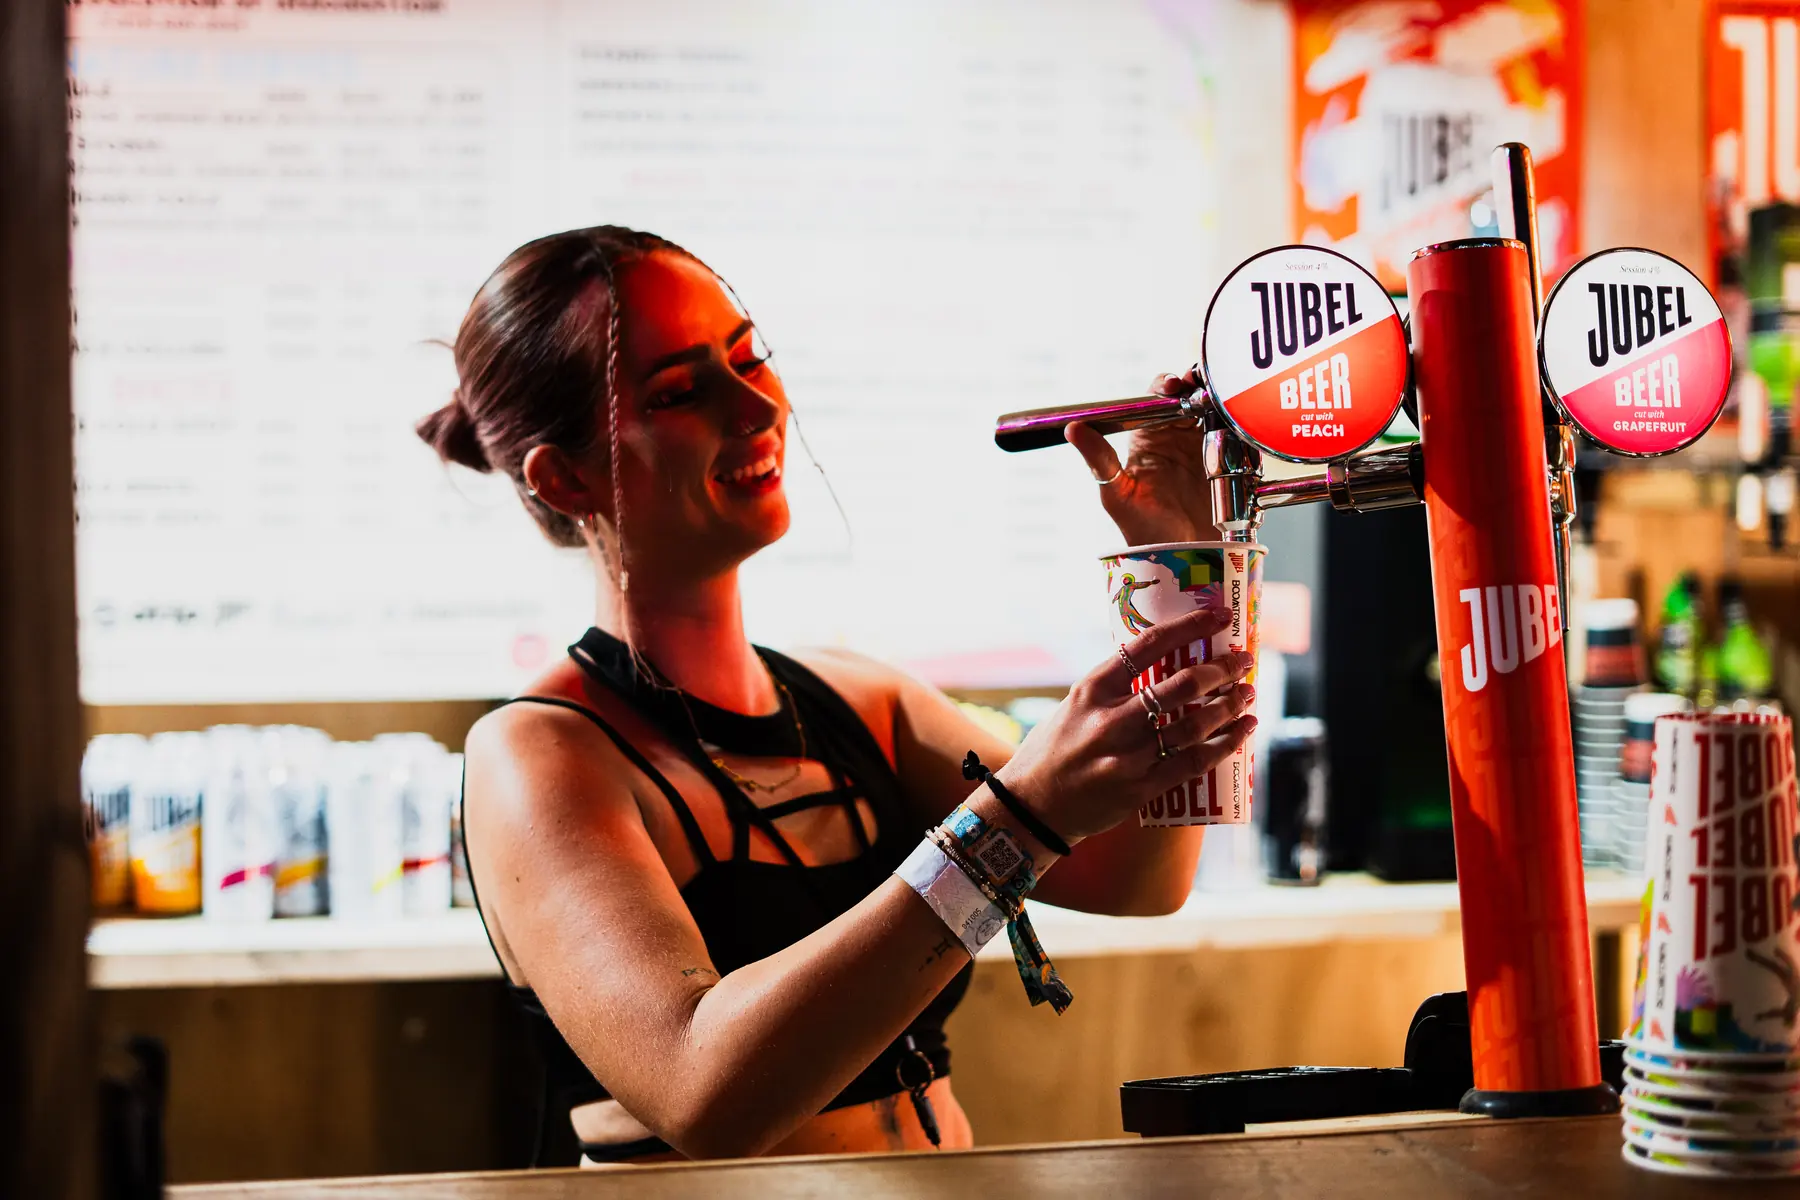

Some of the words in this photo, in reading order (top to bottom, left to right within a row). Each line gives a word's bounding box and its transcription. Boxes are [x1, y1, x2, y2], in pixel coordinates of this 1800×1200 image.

[1285, 262, 1313, 271] Session
[1619, 264, 1647, 274] Session
[1250, 282, 1363, 370] JUBEL
[1587, 282, 1692, 368] JUBEL
[1279, 352, 1352, 410] BEER
[1614, 353, 1682, 408] BEER
[1300, 413, 1314, 421] cut
[1315, 412, 1334, 421] with
[1633, 411, 1647, 419] cut
[1648, 410, 1665, 419] with
[1291, 424, 1345, 438] PEACH
[1613, 420, 1687, 433] GRAPEFRUIT
[1228, 552, 1244, 573] JUBEL
[1230, 579, 1241, 637] BOOMTOWN
[1459, 584, 1563, 692] JUBE
